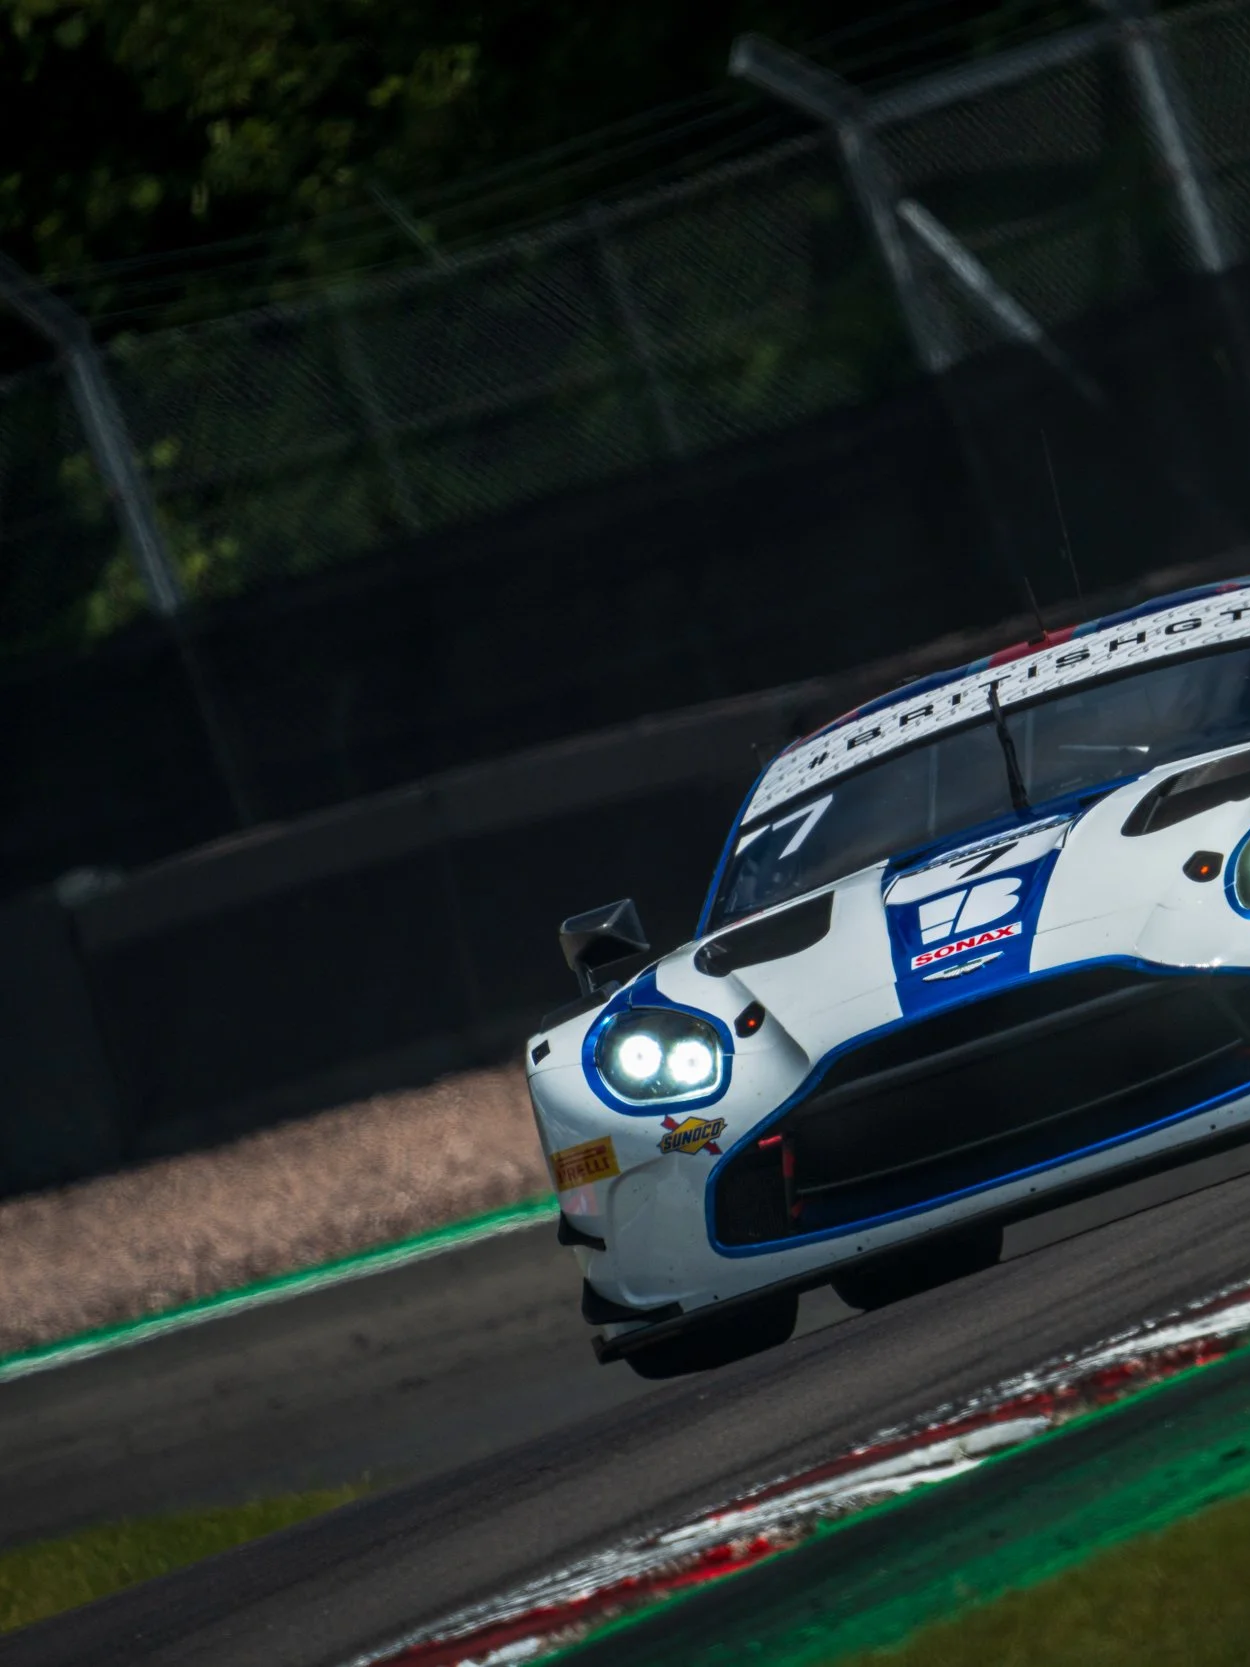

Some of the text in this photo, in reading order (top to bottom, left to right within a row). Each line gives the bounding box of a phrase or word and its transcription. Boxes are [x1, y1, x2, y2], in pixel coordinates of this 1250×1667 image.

[772, 793, 833, 860] 7
[950, 841, 1019, 880] 7
[915, 924, 1015, 967] SONAX
[664, 1120, 722, 1150] SUNOCO
